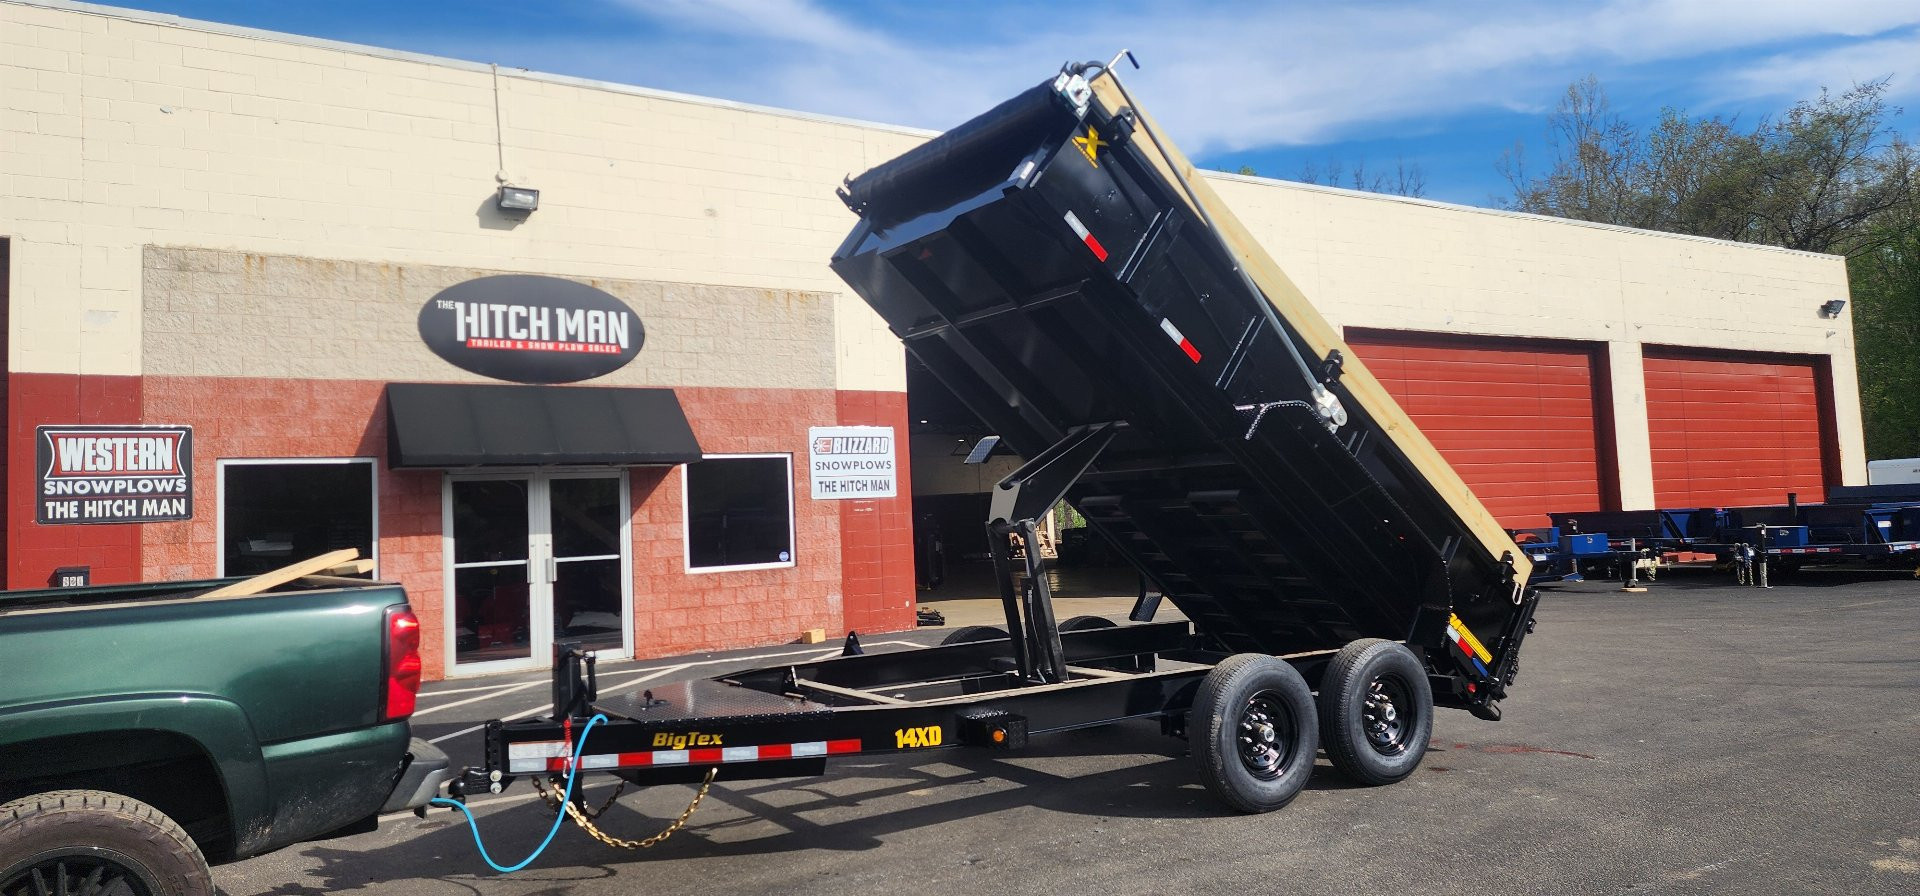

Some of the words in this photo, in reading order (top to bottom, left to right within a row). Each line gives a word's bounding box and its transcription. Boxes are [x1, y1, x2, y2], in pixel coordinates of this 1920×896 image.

[436, 299, 456, 310] THE
[455, 302, 550, 342] HITCH
[555, 307, 629, 349] MAN
[470, 338, 512, 349] TRAILER
[516, 340, 523, 349] &
[528, 341, 555, 350] SNOW
[558, 343, 584, 352] PLOW
[588, 344, 618, 353] SALES
[832, 437, 889, 454] BLIZZARD
[58, 437, 173, 472] WESTERN
[815, 460, 892, 470] SNOWPLOWS
[44, 479, 187, 495] SNOWPLOWS
[818, 481, 837, 493] THE
[840, 480, 868, 492] HITCH
[870, 479, 890, 491] MAN
[46, 501, 78, 519] THE
[84, 500, 136, 518] HITCH
[142, 498, 186, 516] MAN
[652, 732, 723, 750] BigTex
[895, 725, 942, 749] 14XD
